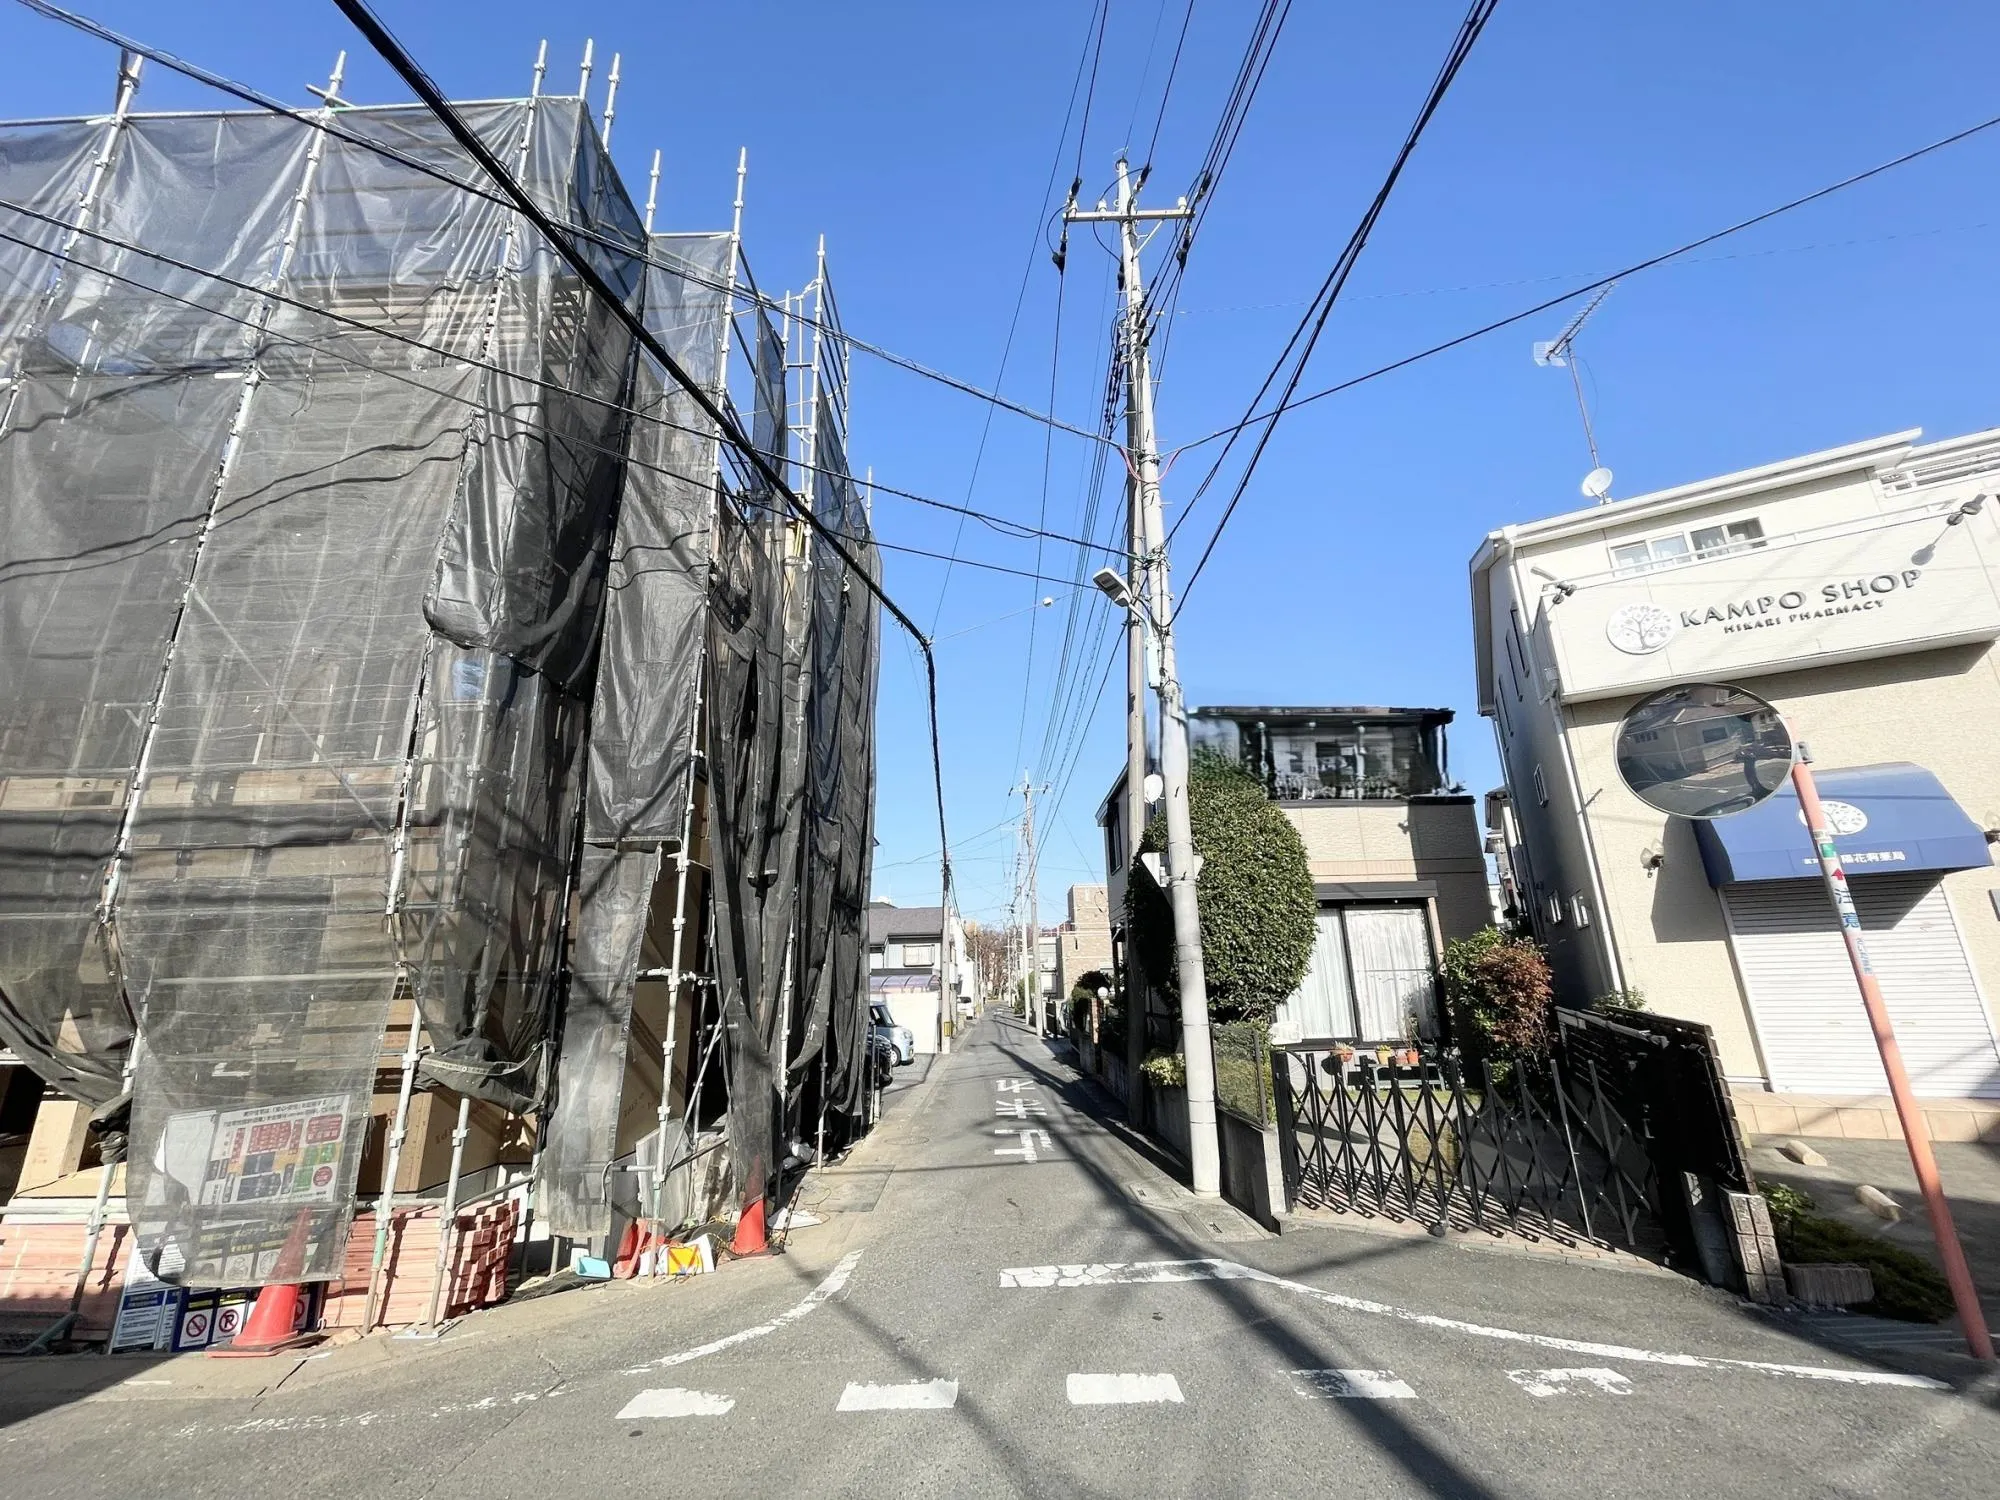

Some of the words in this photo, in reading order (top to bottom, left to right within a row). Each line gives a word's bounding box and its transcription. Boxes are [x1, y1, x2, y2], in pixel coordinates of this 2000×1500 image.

[1680, 591, 1807, 628] KAMPO
[1821, 569, 1922, 603] SHOP
[1724, 617, 1781, 634] HIKARI
[1789, 600, 1884, 623] PHARMACY
[994, 1079, 1055, 1164] 止まれ
